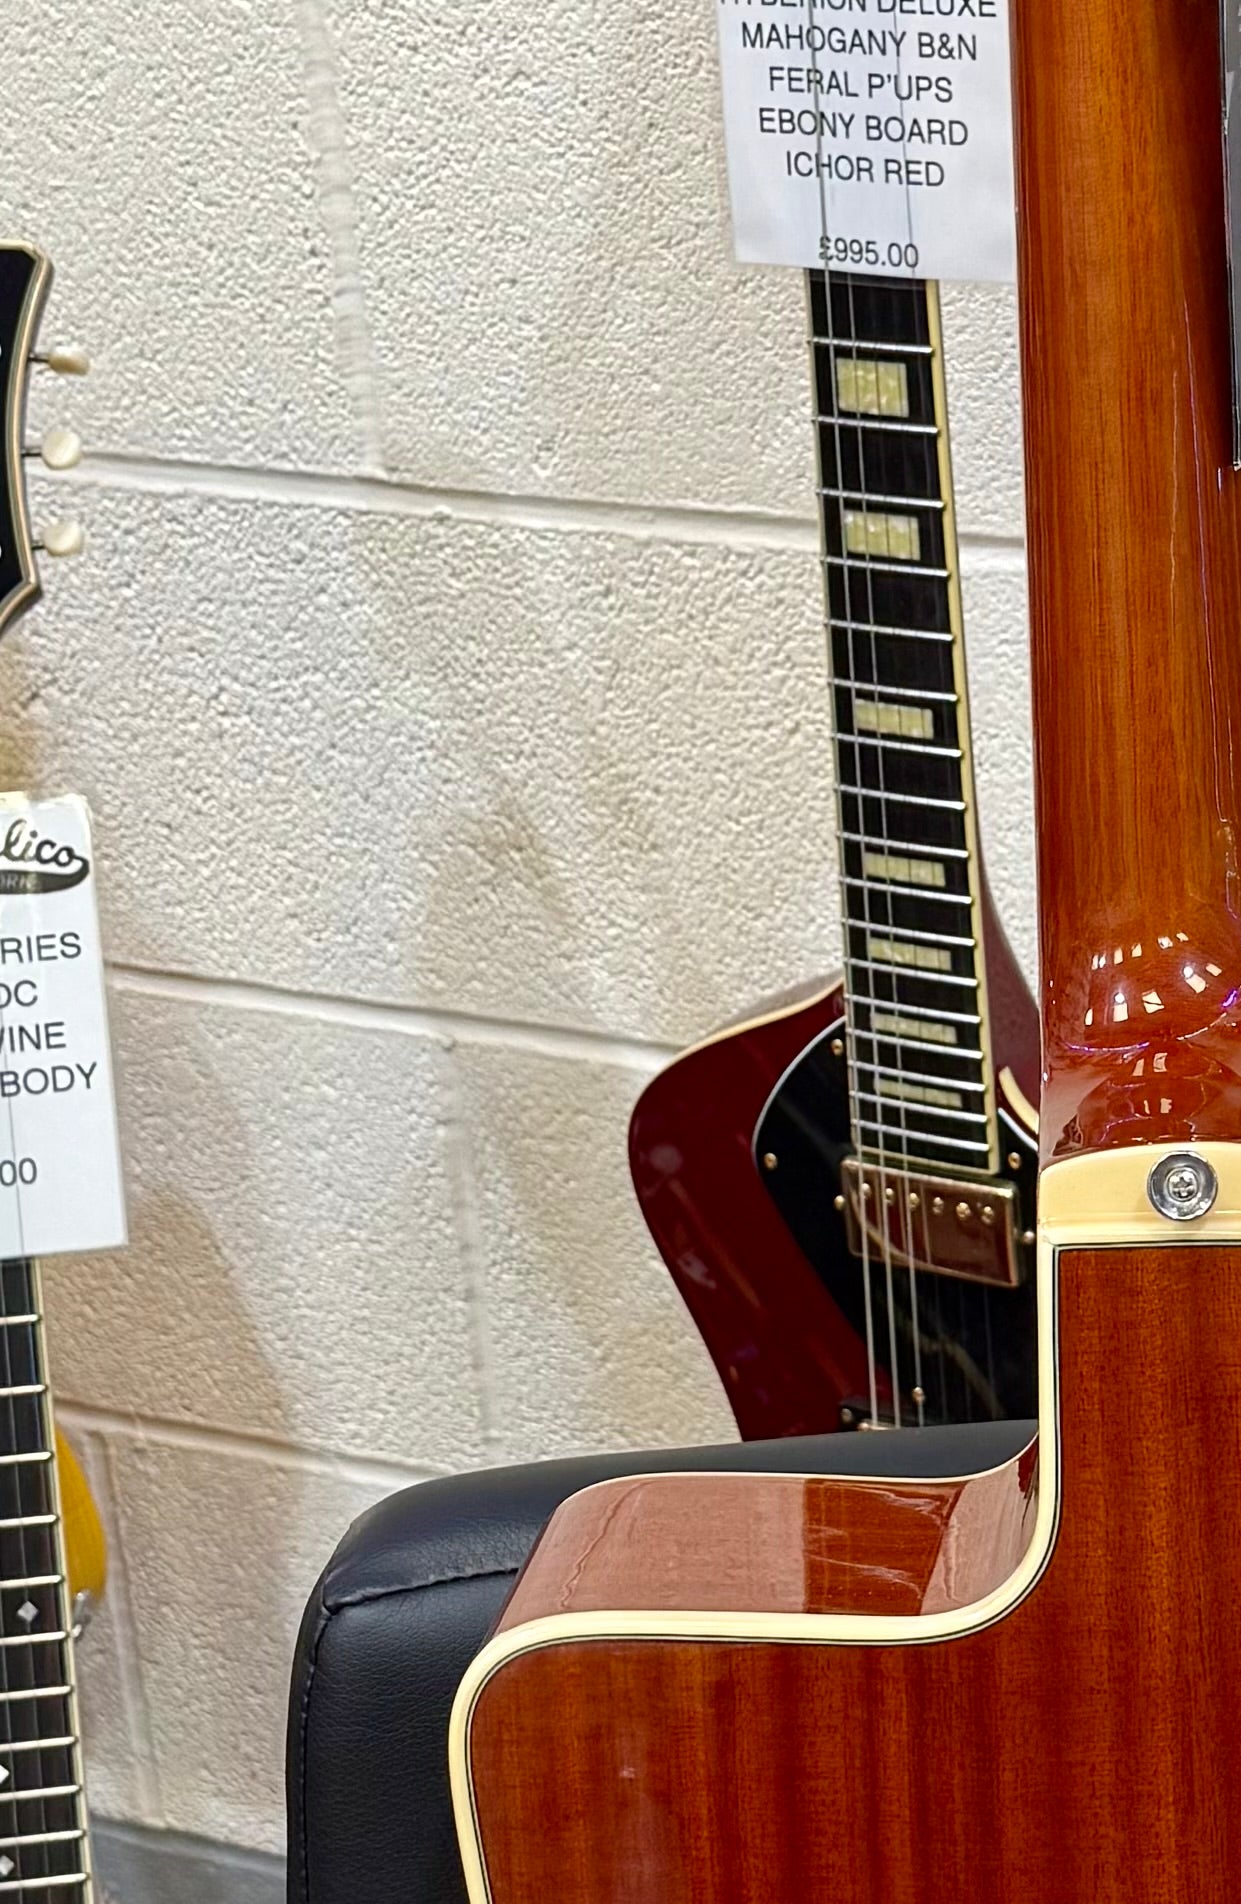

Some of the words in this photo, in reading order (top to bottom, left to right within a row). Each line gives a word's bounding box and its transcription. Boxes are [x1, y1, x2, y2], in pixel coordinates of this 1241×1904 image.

[741, 21, 907, 58] MAHOGANY
[917, 31, 978, 61] B&N
[768, 66, 860, 98] FERAL
[867, 72, 954, 103] P'UPS
[758, 107, 856, 140] EBONY
[865, 114, 969, 146] BOARD
[786, 150, 875, 183] ICHOR
[884, 158, 946, 187] RED
[818, 235, 920, 269] £995.00
[0, 1021, 67, 1054] INE
[0, 1061, 97, 1097] BODY
